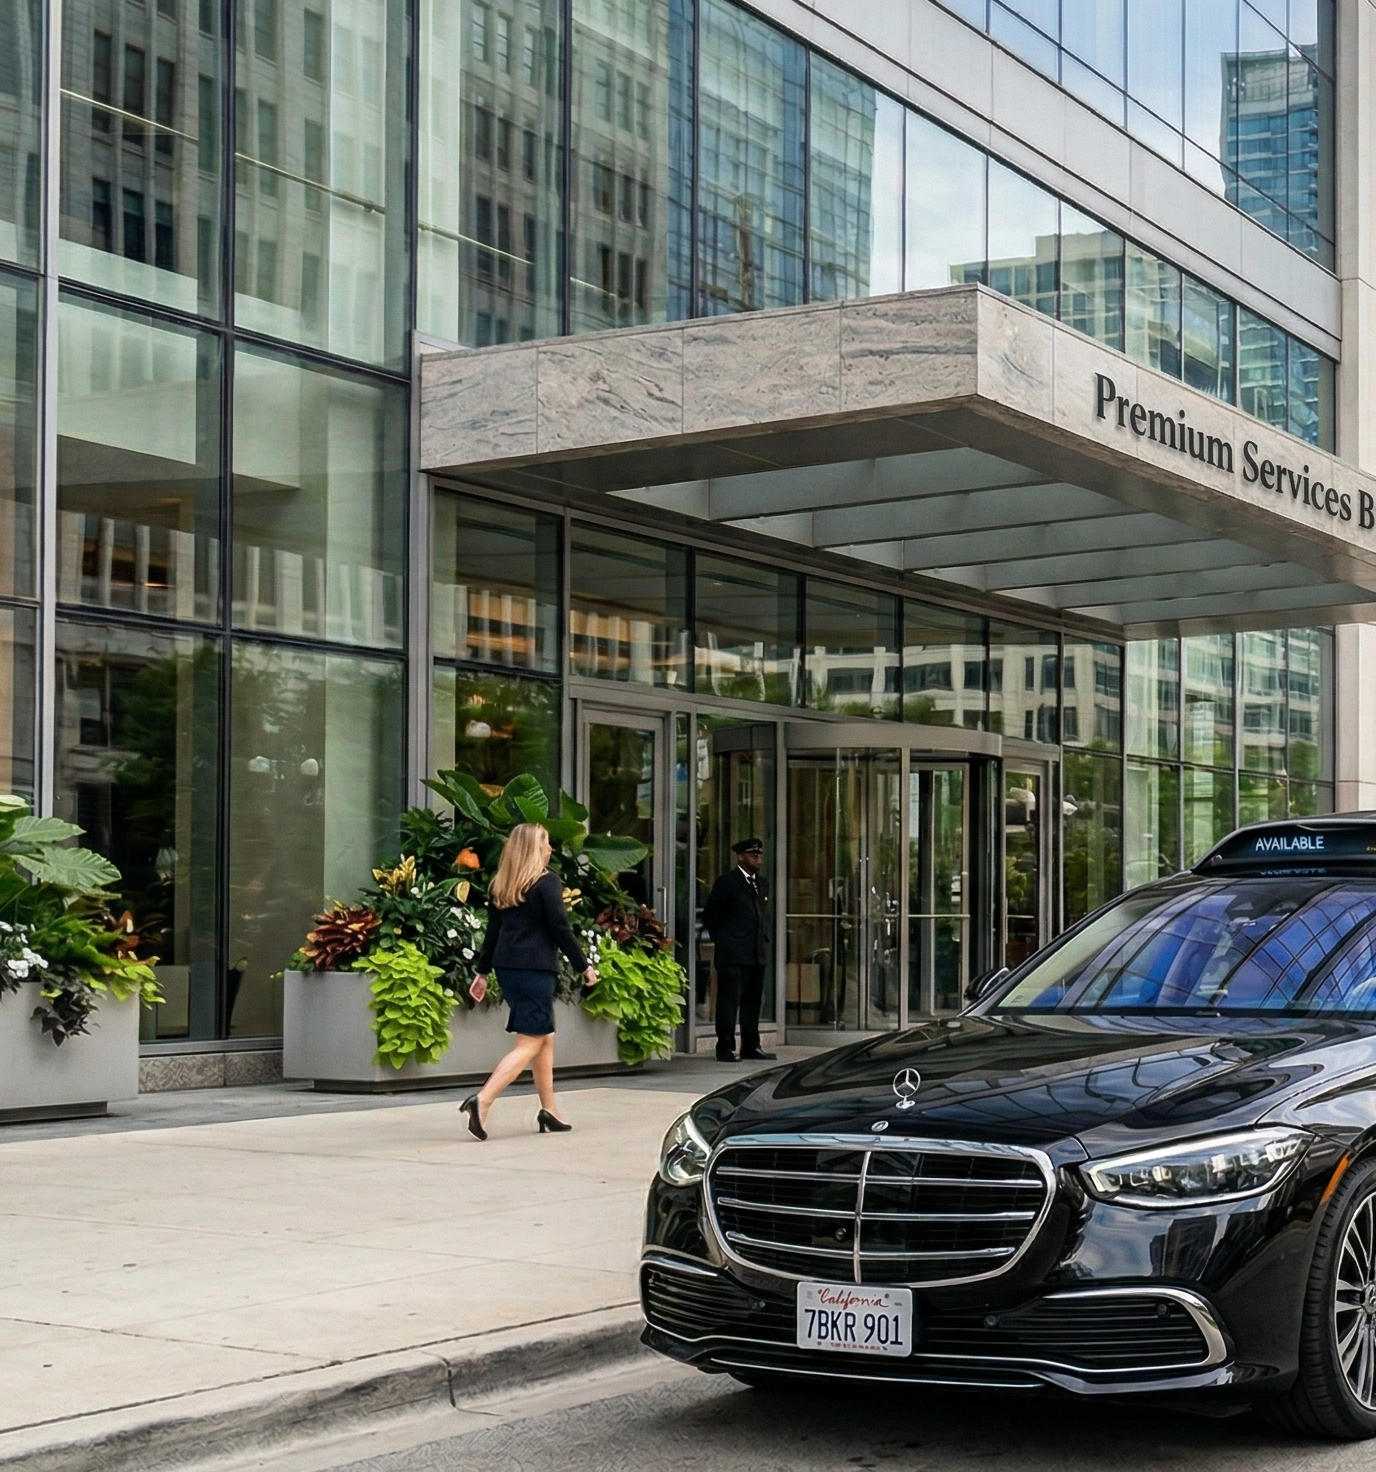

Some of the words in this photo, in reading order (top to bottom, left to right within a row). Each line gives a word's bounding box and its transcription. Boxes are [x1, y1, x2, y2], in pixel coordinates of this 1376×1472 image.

[1094, 372, 1235, 473] Premium
[1242, 440, 1352, 521] Services
[1255, 836, 1325, 851] AVAILABLE
[820, 1287, 889, 1310] California
[804, 1308, 857, 1342] 7BKR
[863, 1313, 904, 1346] 901
